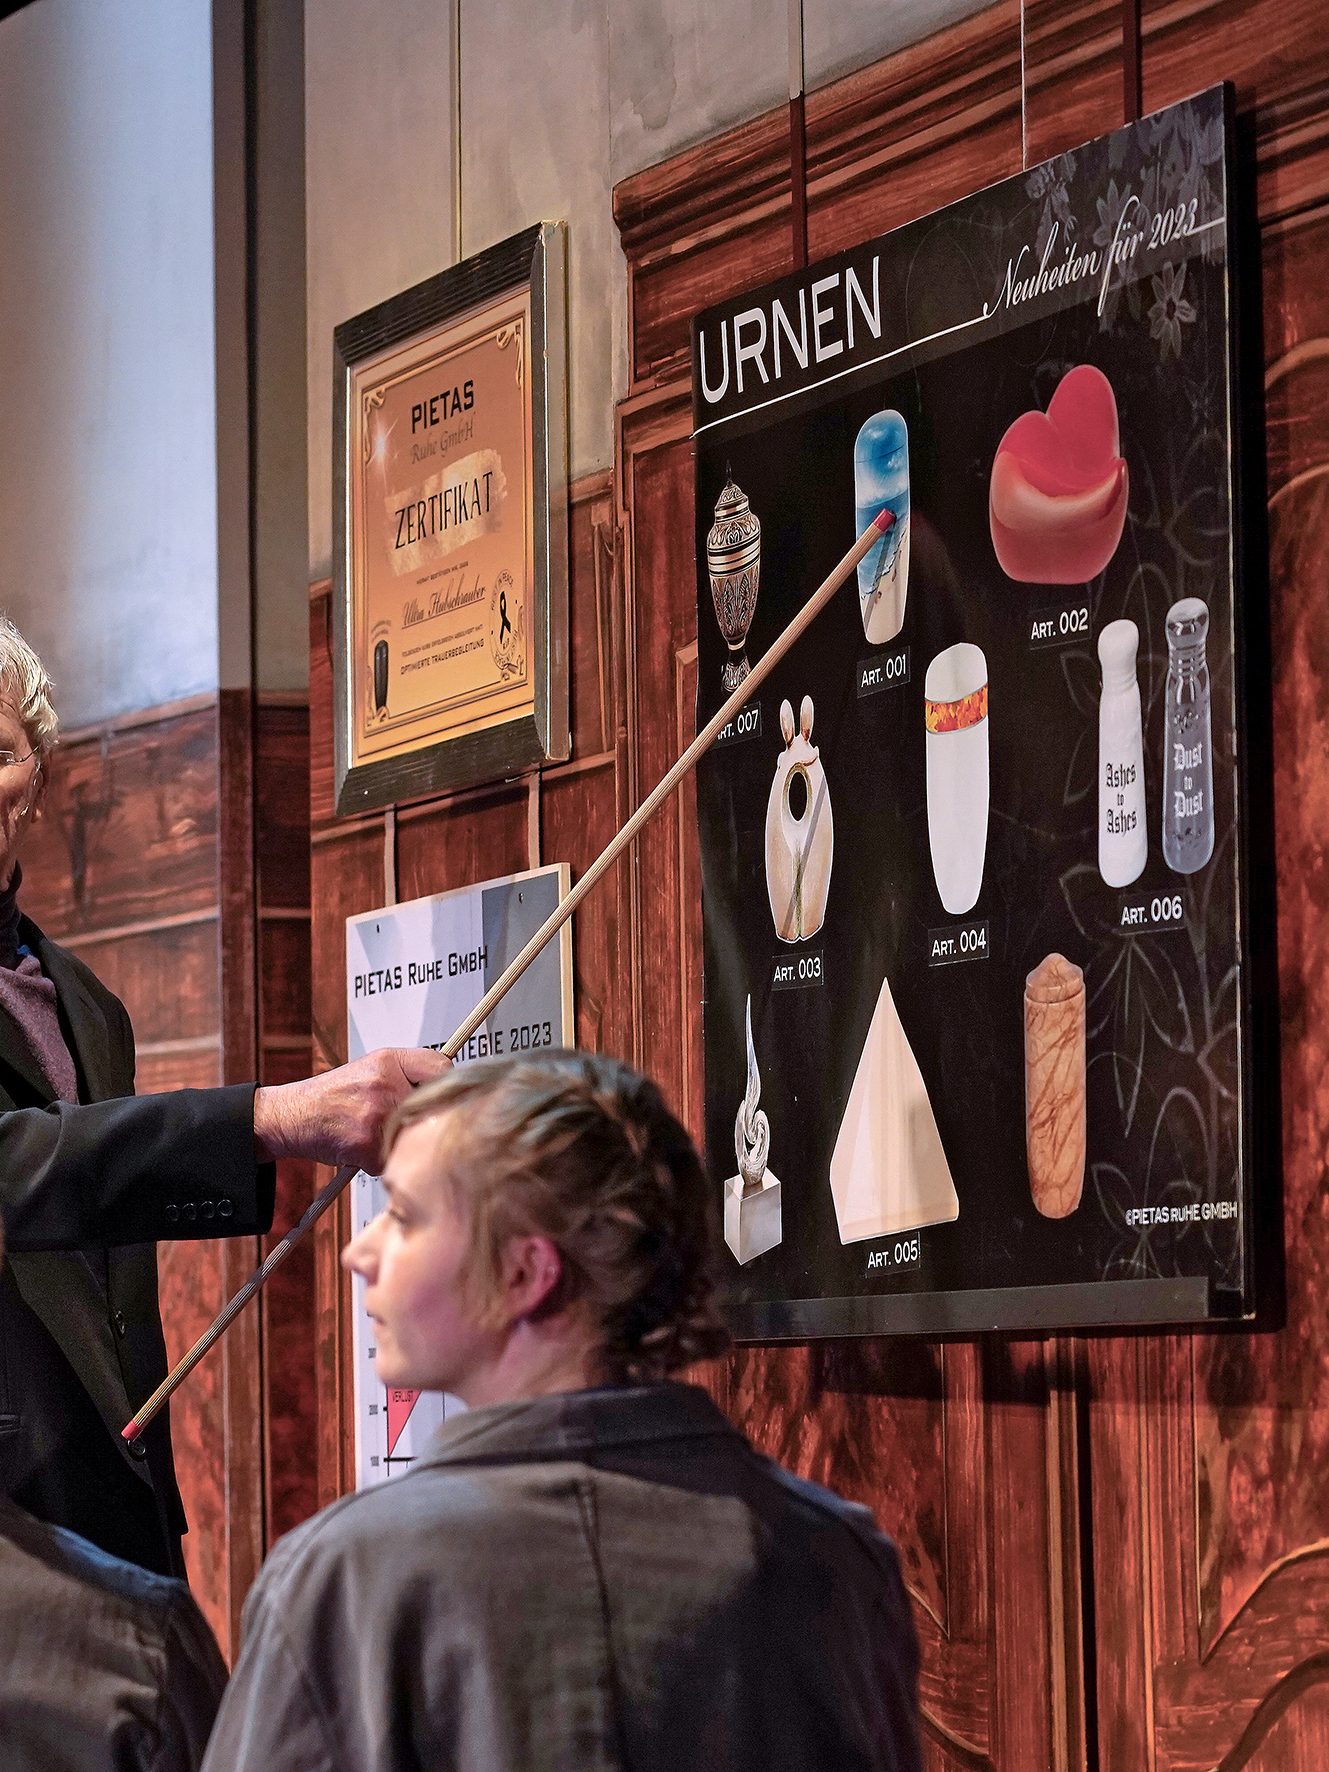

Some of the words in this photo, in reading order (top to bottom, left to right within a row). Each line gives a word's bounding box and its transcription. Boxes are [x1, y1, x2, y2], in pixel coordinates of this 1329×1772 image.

[984, 221, 1103, 318] Neuheiten
[1098, 195, 1145, 317] für
[1147, 198, 1199, 250] 2023
[699, 256, 882, 404] URNEN
[411, 379, 474, 434] PIETAS
[395, 470, 493, 549] ZERTIFIKAT
[1059, 607, 1090, 635] 002
[886, 654, 907, 680] 001
[717, 722, 735, 740] RT.
[737, 709, 759, 734] 007
[1173, 742, 1203, 771] Dust
[1174, 789, 1204, 818] Dust
[1150, 895, 1184, 921] 006
[959, 927, 987, 952] 004
[354, 965, 403, 999] PIETAS
[798, 956, 821, 980] 003
[510, 1021, 553, 1052] 2023
[1170, 1203, 1201, 1222] RUHE
[1201, 1201, 1238, 1220] GMBH
[893, 1239, 918, 1264] 005
